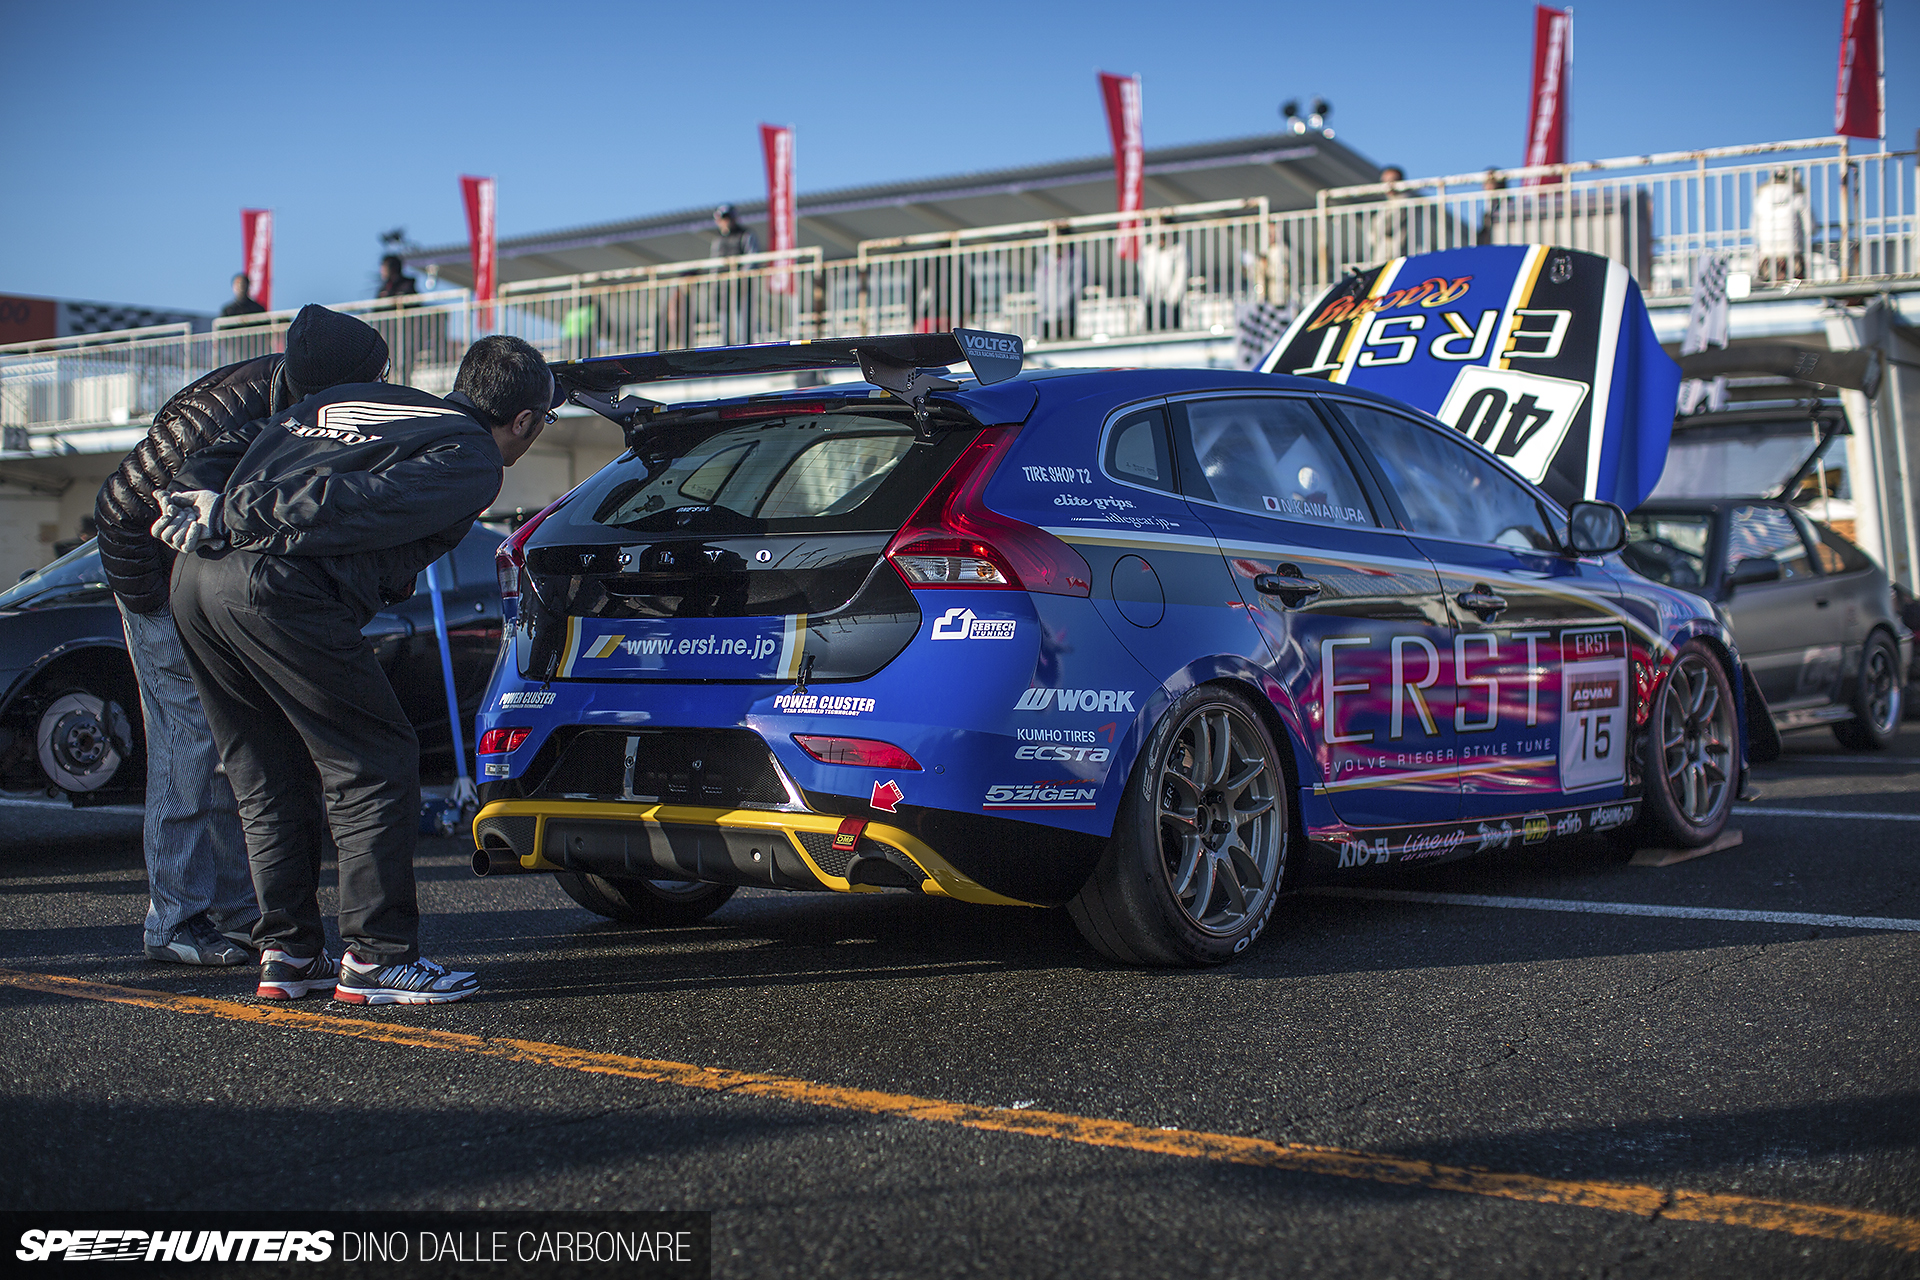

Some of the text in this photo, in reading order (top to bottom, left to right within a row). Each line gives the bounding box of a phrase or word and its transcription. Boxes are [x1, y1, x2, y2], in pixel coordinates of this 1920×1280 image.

[1306, 276, 1474, 333] Racing
[965, 335, 1017, 353] VOLTEX
[1292, 308, 1573, 376] ERST
[1454, 387, 1554, 458] 40
[1022, 466, 1093, 484] TIRE SHOP T2
[1053, 494, 1137, 511] elite grips.
[1280, 498, 1367, 523] N.KAWAMURA
[579, 549, 773, 568] VOLVO
[972, 622, 1015, 632] REBTECH
[975, 630, 1010, 638] TUNING
[626, 634, 776, 660] www.erst.ne.jp
[1575, 632, 1611, 656] ERST
[1320, 631, 1552, 745] ERST
[1572, 686, 1613, 702] ADVAN
[498, 691, 557, 706] POWER CLUSTER
[773, 694, 876, 713] POWER CLUSTER
[1056, 688, 1136, 713] WORK
[1017, 728, 1097, 743] KUMHO TIRES
[1579, 714, 1612, 762] 15
[1323, 738, 1552, 775] EVOLVE RIEGER STYLE TUNE
[984, 784, 1097, 802] 5ZIGEN
[836, 835, 854, 844] OMP
